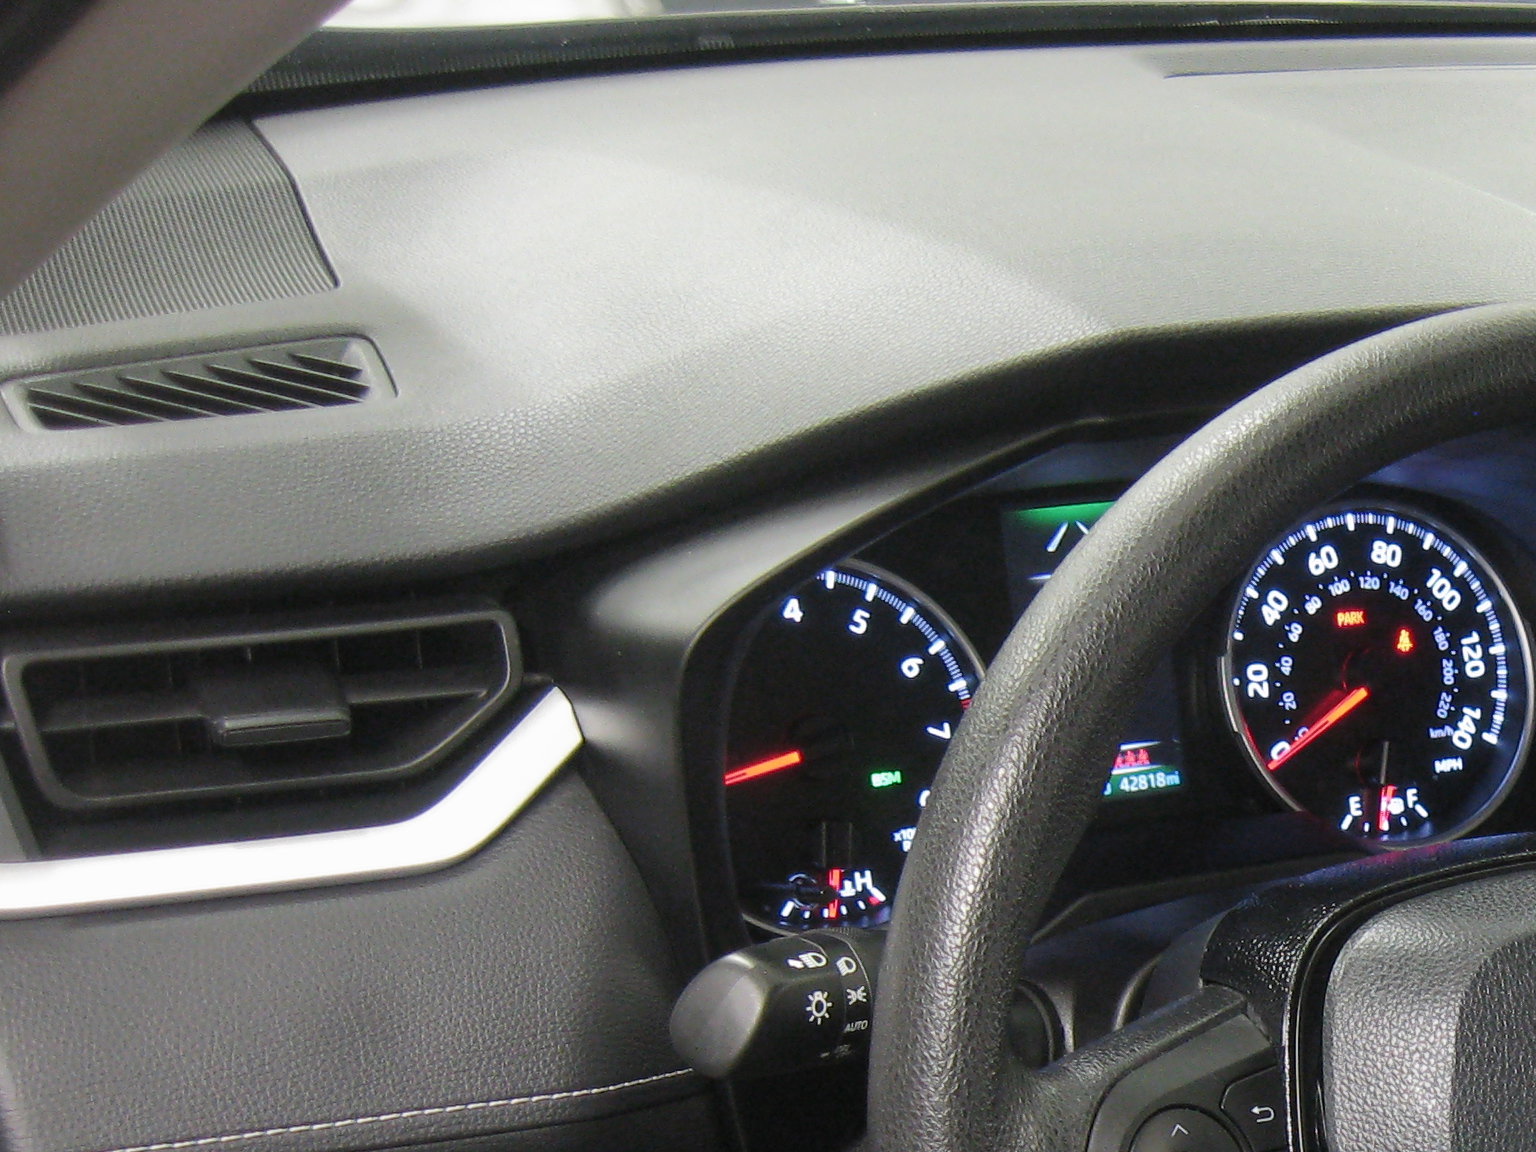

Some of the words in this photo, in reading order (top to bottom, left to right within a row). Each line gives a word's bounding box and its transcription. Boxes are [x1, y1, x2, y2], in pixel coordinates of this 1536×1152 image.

[1308, 545, 1339, 576] 60
[1371, 540, 1402, 568] 80
[1328, 578, 1351, 597] 100
[1358, 576, 1381, 590] 120
[1389, 581, 1410, 601] 140
[1426, 568, 1462, 612] 100
[783, 598, 803, 622] 4
[1261, 589, 1289, 627] 40
[1305, 596, 1322, 615] 80
[1414, 598, 1434, 623] 160
[849, 608, 870, 635] 5
[1336, 611, 1365, 628] PARK
[1288, 622, 1304, 643] 60
[1433, 626, 1450, 652] 180
[1280, 655, 1294, 677] 40
[1460, 630, 1486, 679] 120
[901, 656, 924, 679] 6
[1442, 658, 1455, 686] 200
[1246, 662, 1270, 699] 20
[1282, 691, 1298, 711] 20
[1436, 691, 1453, 720] 220
[1452, 706, 1482, 751] 140
[1434, 756, 1463, 774] MPH
[1348, 795, 1363, 817] E
[1406, 787, 1419, 809] F
[853, 869, 873, 892] H
[843, 1019, 869, 1033] AUTO
